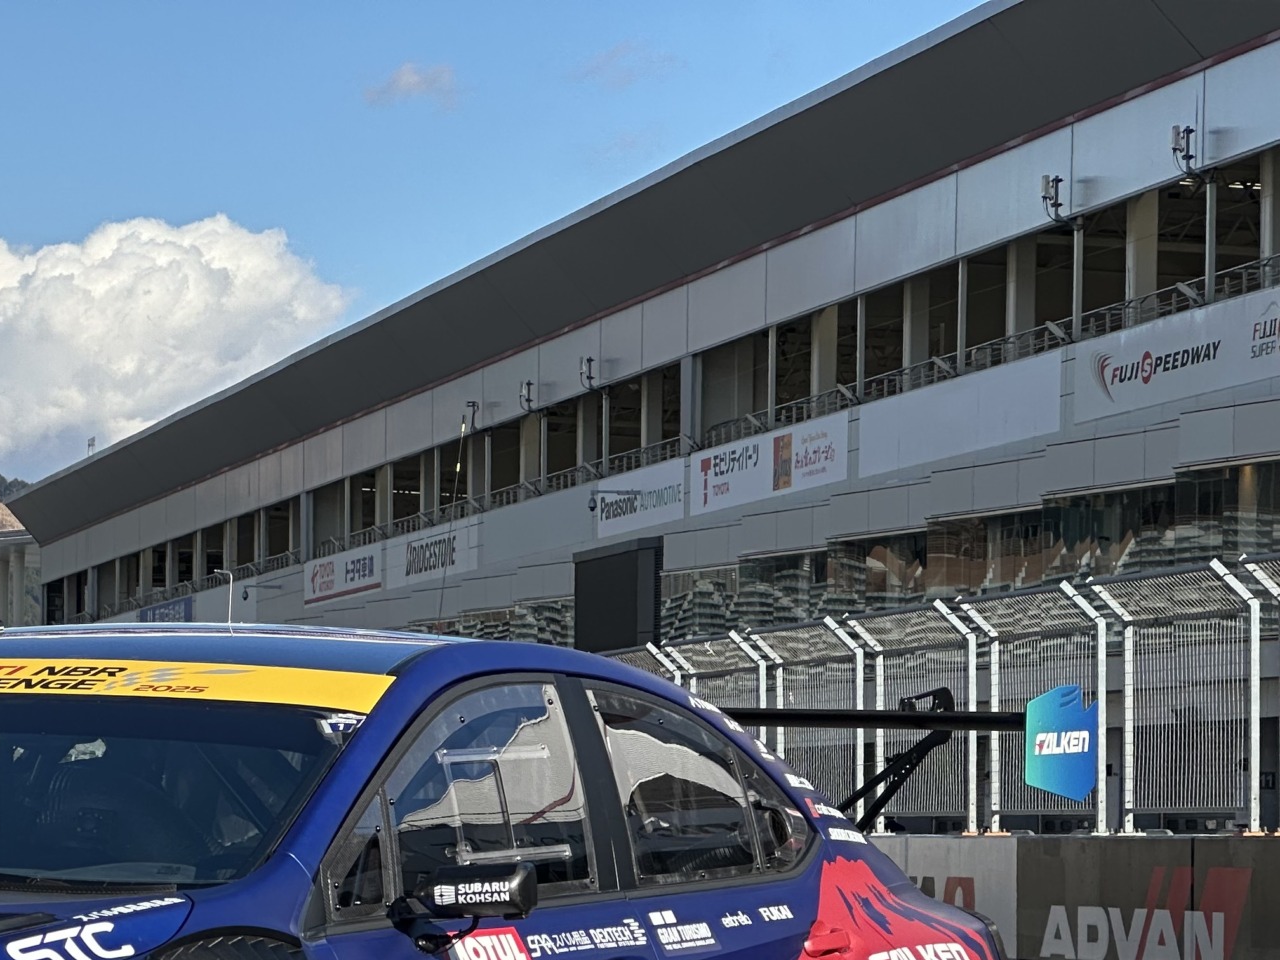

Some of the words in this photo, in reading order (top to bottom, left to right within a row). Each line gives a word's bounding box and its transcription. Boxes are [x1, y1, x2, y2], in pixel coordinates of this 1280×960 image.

[712, 482, 730, 497] TOYOTA
[600, 494, 638, 522] Panasonic
[639, 483, 682, 512] AUTOMOTIVE
[405, 535, 457, 577] BRIDGESTONE
[30, 666, 128, 677] NBR
[133, 684, 209, 693] 2025
[1034, 730, 1089, 756] FALKEN
[458, 882, 510, 894] SUBARU
[458, 892, 510, 904] KOHSAN
[589, 926, 634, 943] DEXTECH
[657, 927, 681, 944] GRAN
[678, 922, 712, 941] TURISMO
